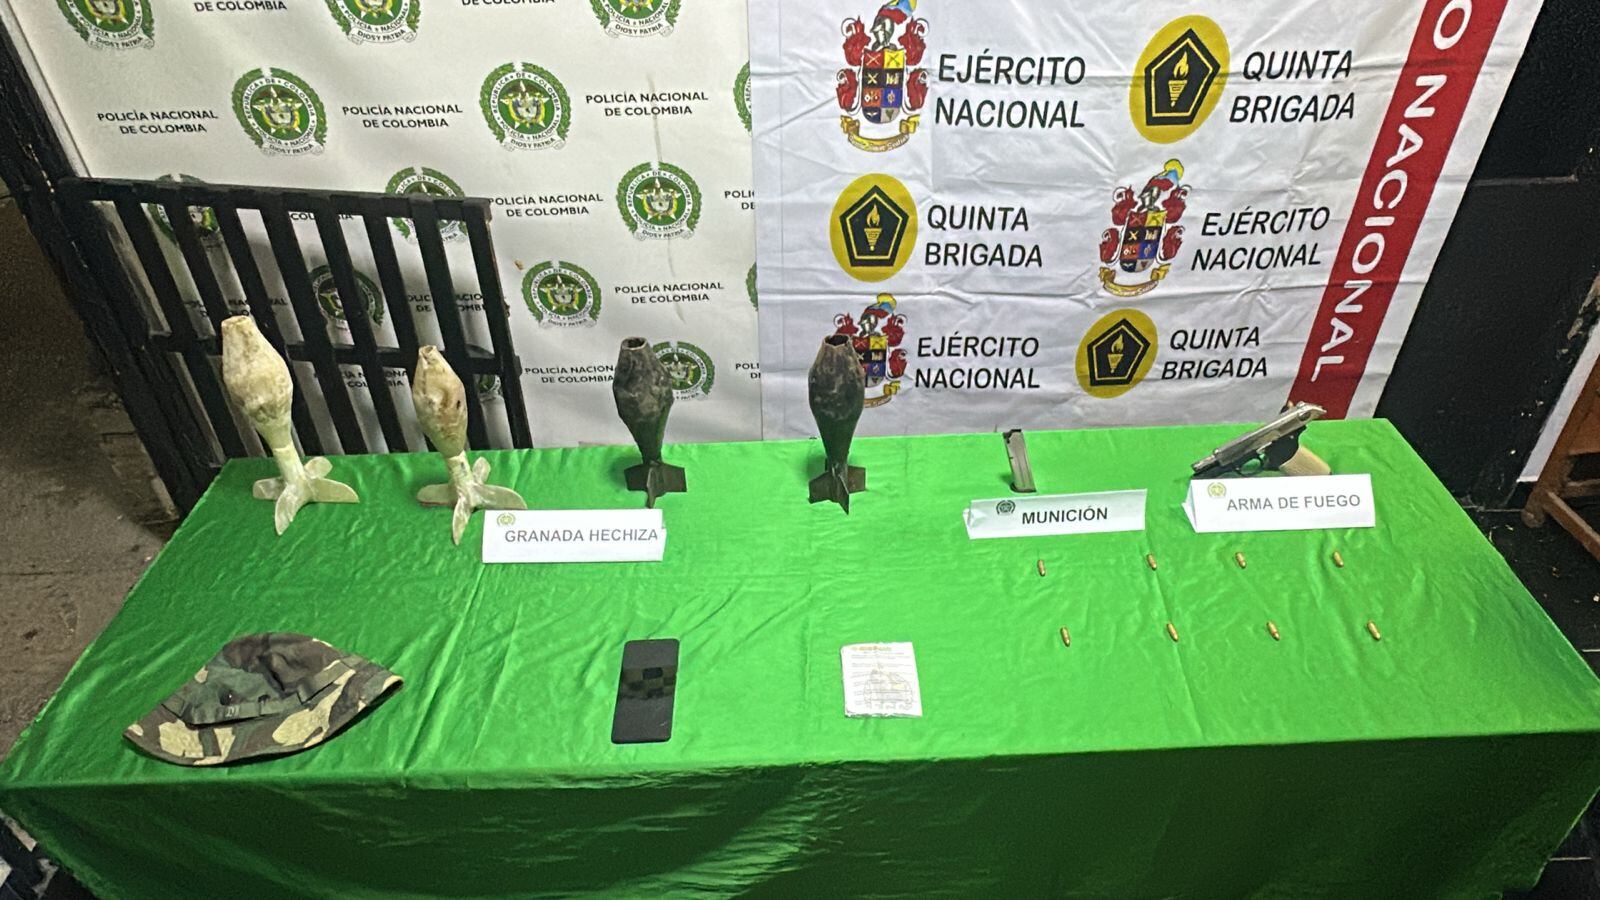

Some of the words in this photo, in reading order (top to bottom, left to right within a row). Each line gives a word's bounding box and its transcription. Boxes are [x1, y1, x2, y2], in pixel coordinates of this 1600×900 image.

[194, 2, 214, 12] DE
[216, 1, 287, 11] COLOMBIA
[938, 48, 1086, 86] EJÉRCITO
[1242, 50, 1354, 82] QUINTA
[585, 91, 638, 104] POLICÍA
[640, 92, 708, 103] NACIONAL
[97, 109, 149, 121] POLICÍA
[150, 110, 218, 120] NACIONAL
[342, 105, 393, 116] POLICÍA
[395, 104, 463, 115] NACIONAL
[604, 107, 621, 117] DE
[624, 106, 693, 116] COLOMBIA
[935, 97, 1085, 129] NACIONAL
[1229, 91, 1355, 124] BRIGADA
[120, 125, 138, 135] DE
[140, 124, 207, 134] COLOMBIA
[363, 119, 380, 128] DE
[382, 118, 449, 129] COLOMBIA
[539, 193, 604, 204] NACIONAL
[724, 190, 755, 199] POLI
[506, 209, 523, 217] DE
[525, 206, 590, 217] COLOMBIA
[927, 204, 1029, 232] QUINTA
[1201, 206, 1331, 237] EJÉRCITO
[1311, 74, 1448, 383] NACIONAL
[924, 242, 1043, 268] BRIGADA
[1190, 243, 1321, 272] NACIONAL
[614, 282, 661, 295] POLICÍA
[662, 282, 724, 293] NACIONAL
[631, 296, 648, 304] DE
[649, 293, 710, 304] COLOMBIA
[917, 331, 1040, 358] EJÉRCITO
[1169, 326, 1260, 352] QUINTA
[524, 366, 568, 375] POLICÍA
[1160, 357, 1267, 381] BRIGADA
[541, 376, 556, 384] DE
[558, 374, 614, 384] COLOMBIA
[915, 367, 1041, 390] NACIONAL
[1227, 496, 1273, 511] ARMA
[1278, 496, 1299, 510] DE
[1304, 494, 1361, 508] FUEGO
[1021, 506, 1108, 525] MUNICIÓN
[505, 529, 584, 543] GRANADA
[589, 528, 658, 542] HECHIZA
